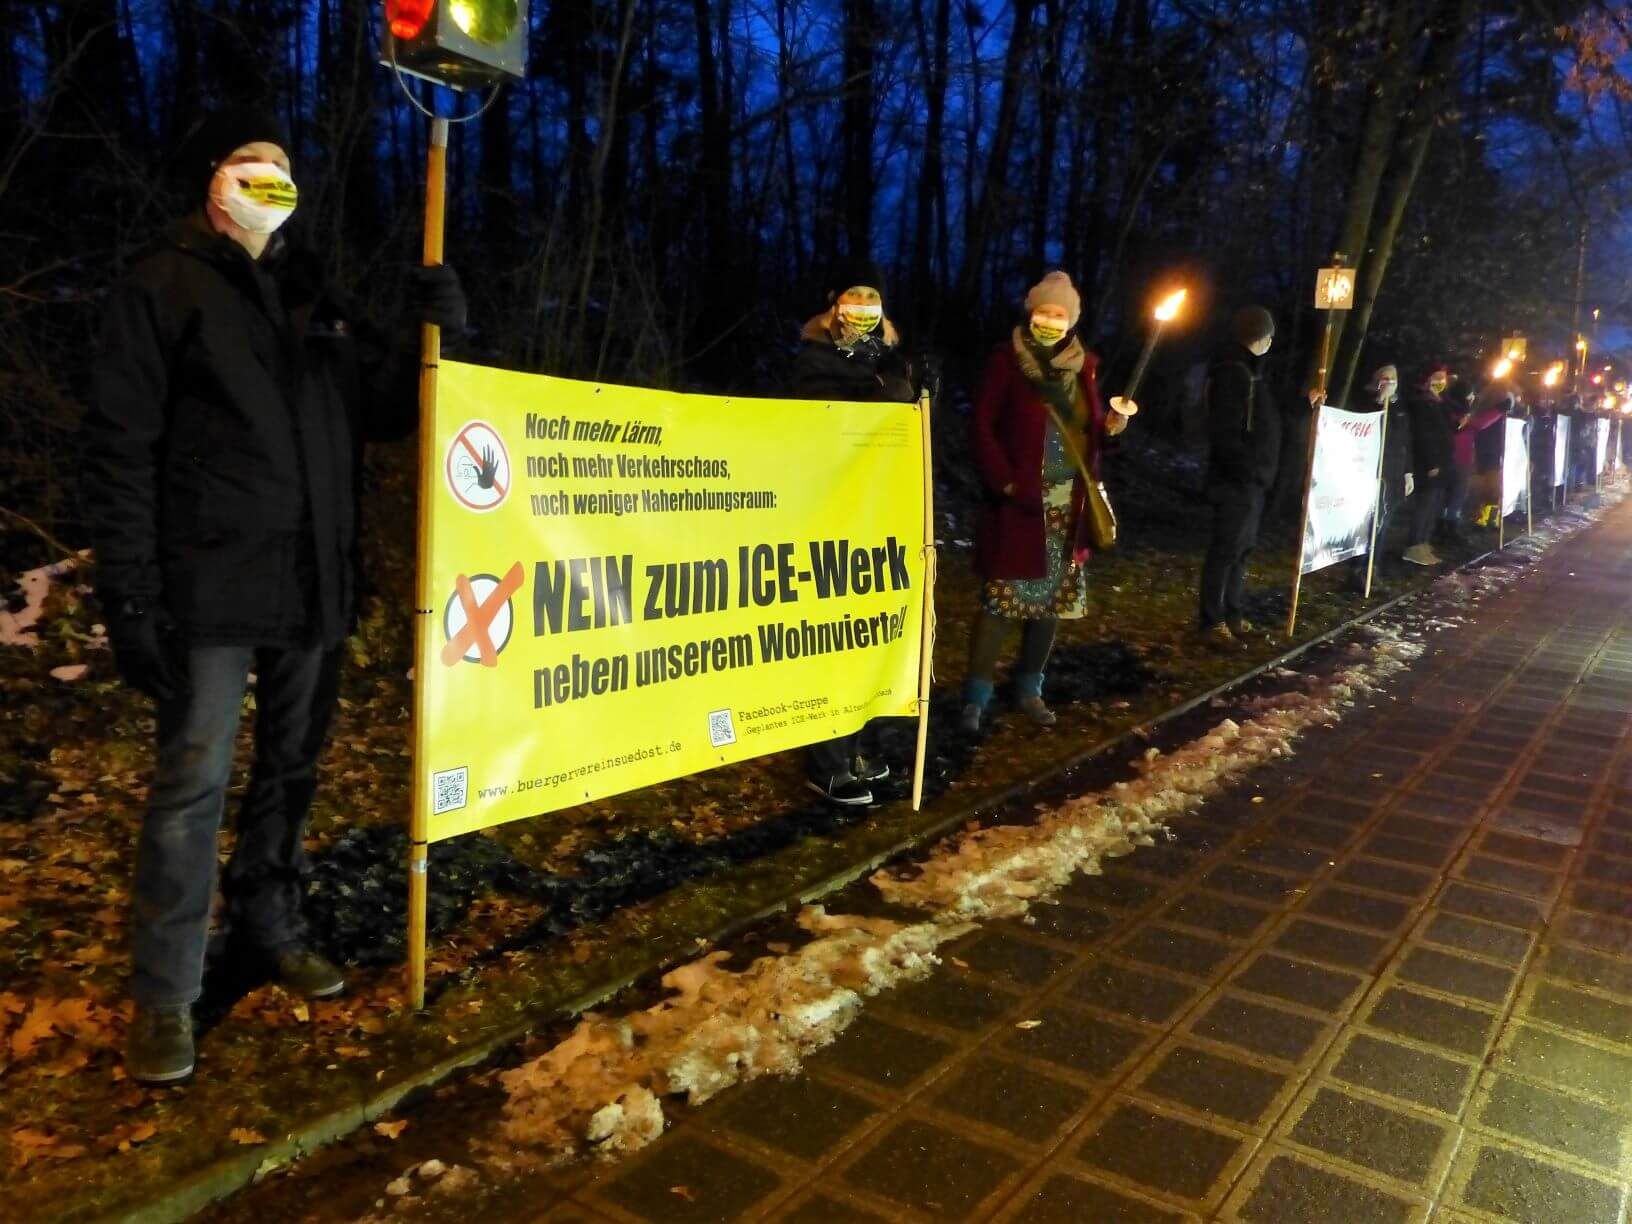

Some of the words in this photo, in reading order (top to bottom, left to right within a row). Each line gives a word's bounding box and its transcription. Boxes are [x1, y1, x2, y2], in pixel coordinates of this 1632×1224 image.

[526, 413, 570, 440] Noch
[573, 420, 622, 443] mehr
[621, 420, 662, 447] Lärm,
[527, 452, 569, 478] noch
[573, 454, 613, 478] mehr
[616, 454, 730, 480] Verkehrschaos,
[530, 490, 569, 516] noch
[573, 490, 638, 516] weniger
[642, 488, 776, 512] Naherholungsraum:
[533, 555, 633, 637] NEIN
[644, 559, 728, 621] zum
[739, 537, 910, 608] ICE-Werk
[534, 654, 628, 709] neben
[636, 637, 753, 687] unserem
[738, 697, 828, 722] Facebook-Gruppe
[478, 741, 682, 799] www.buergervereinsuedost.de
